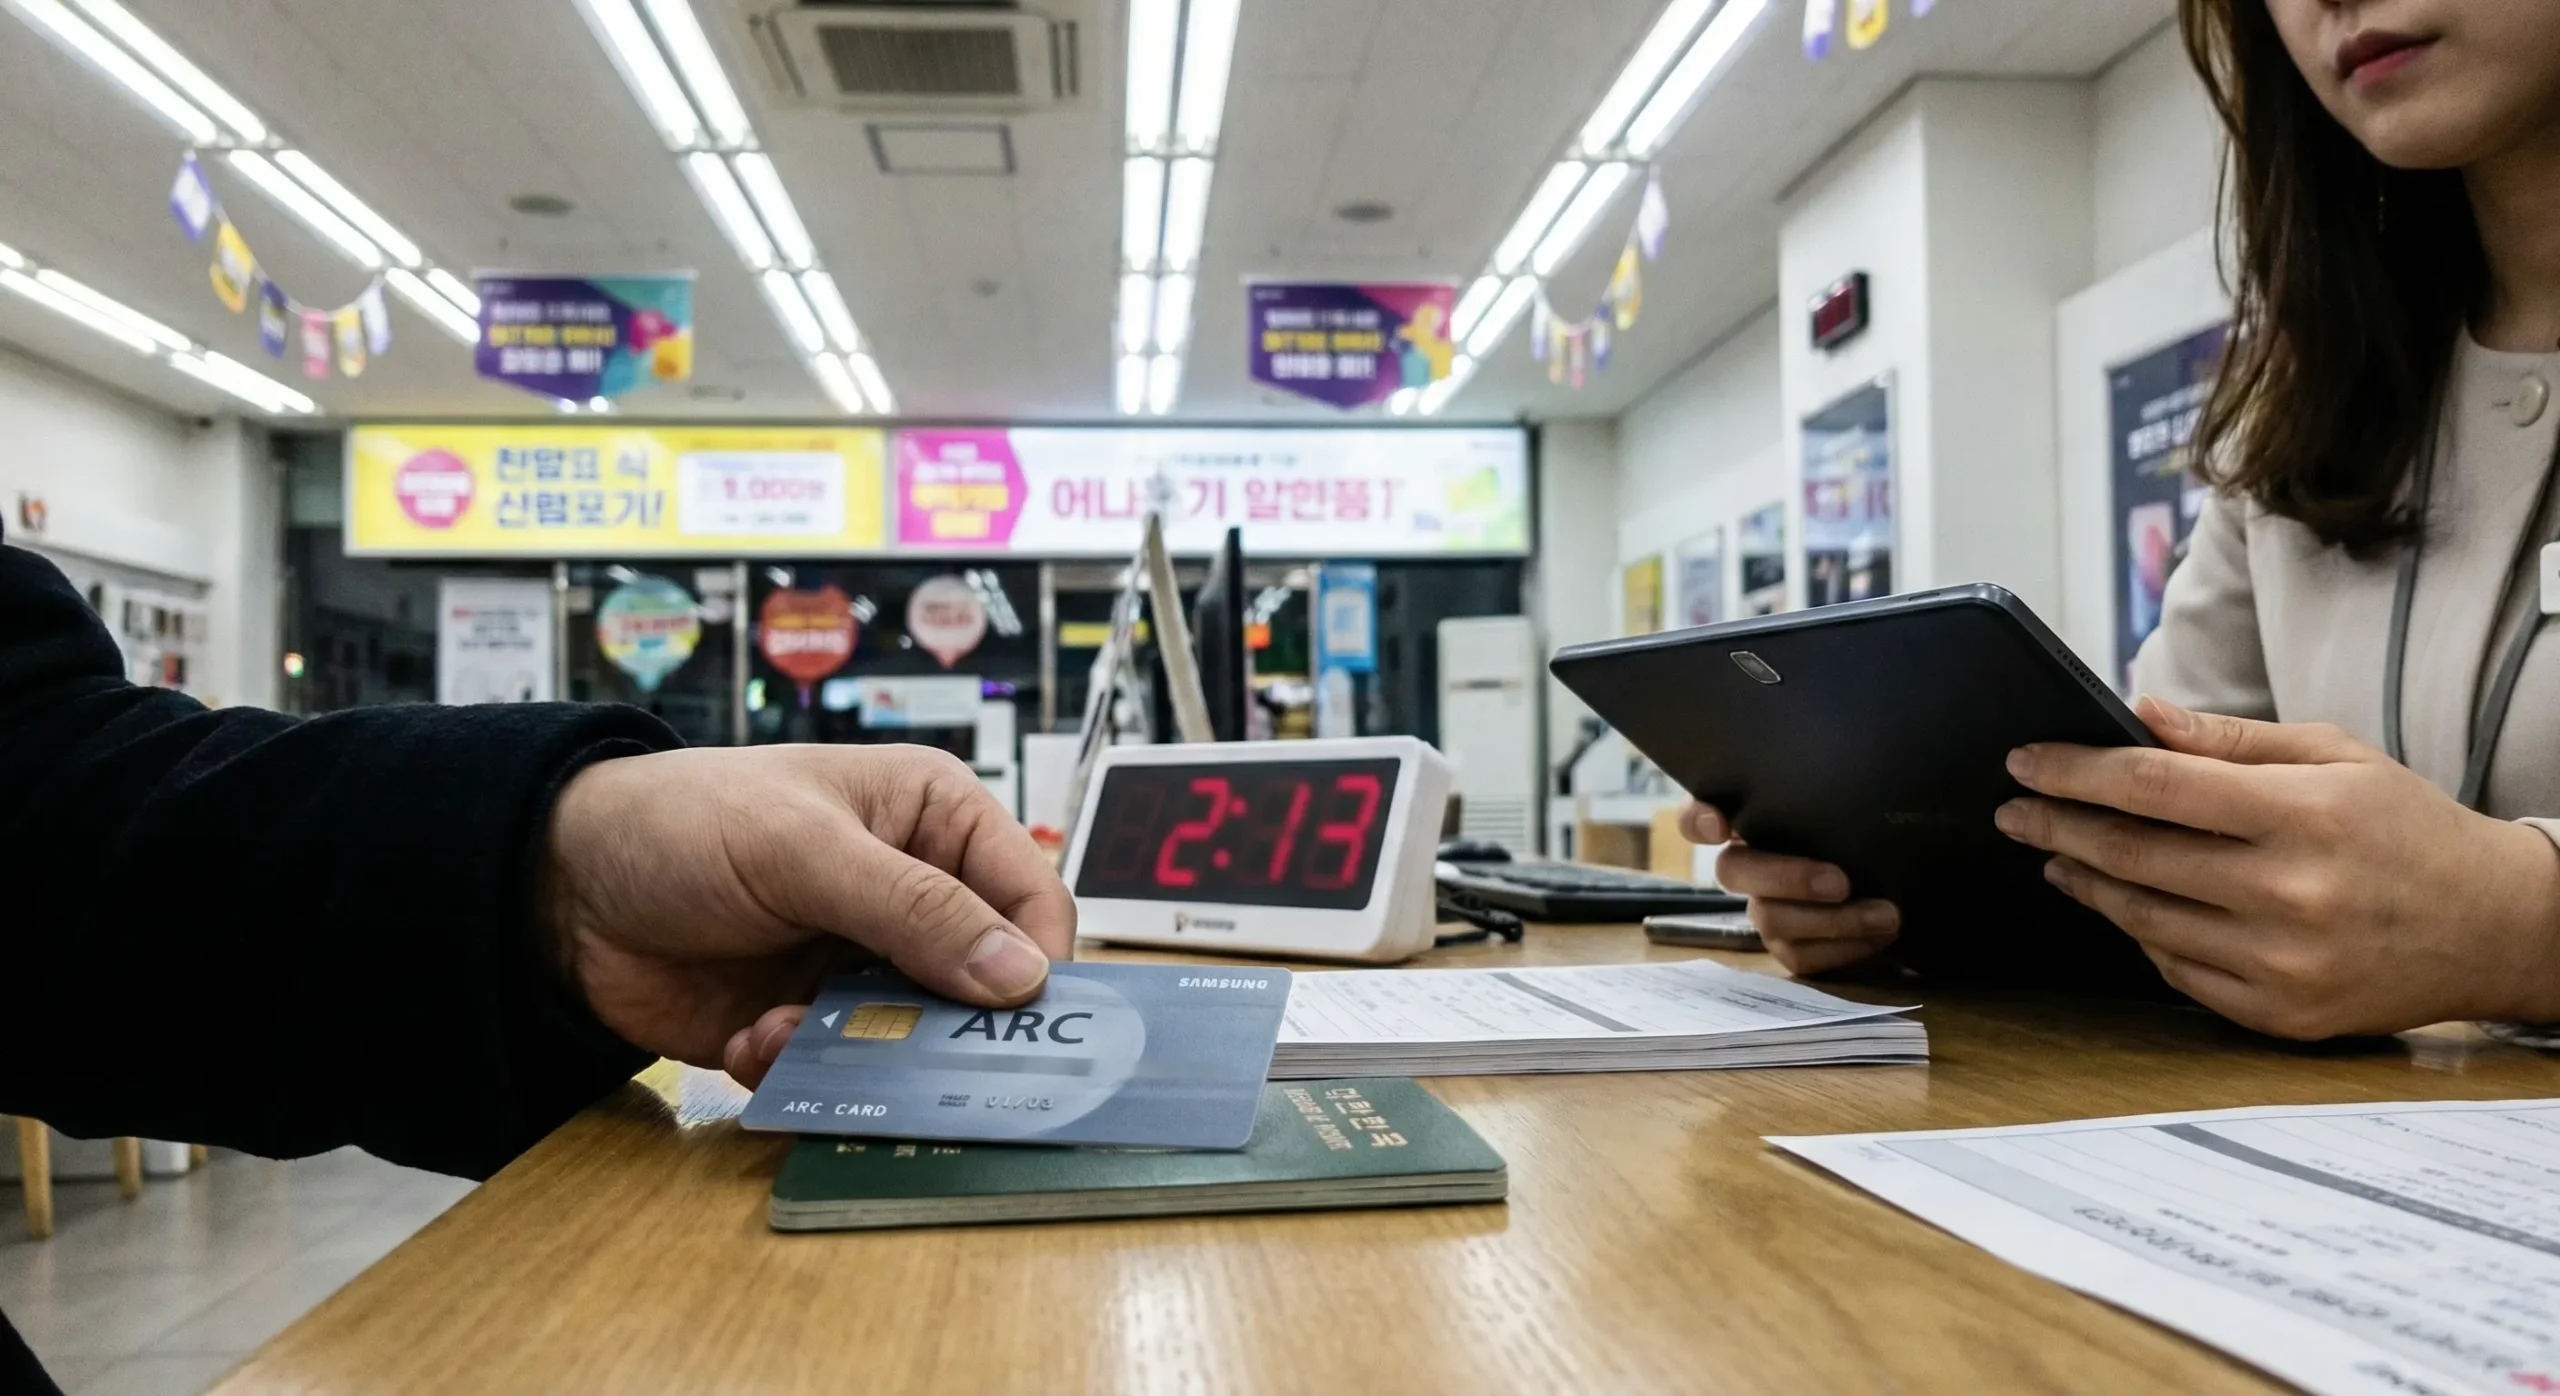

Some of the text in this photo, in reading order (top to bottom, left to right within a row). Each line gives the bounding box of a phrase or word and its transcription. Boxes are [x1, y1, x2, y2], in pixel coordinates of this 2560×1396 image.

[1154, 774, 1382, 887] 2:13
[948, 1010, 1094, 1045] ARC
[782, 1101, 888, 1118] ARC CARD
